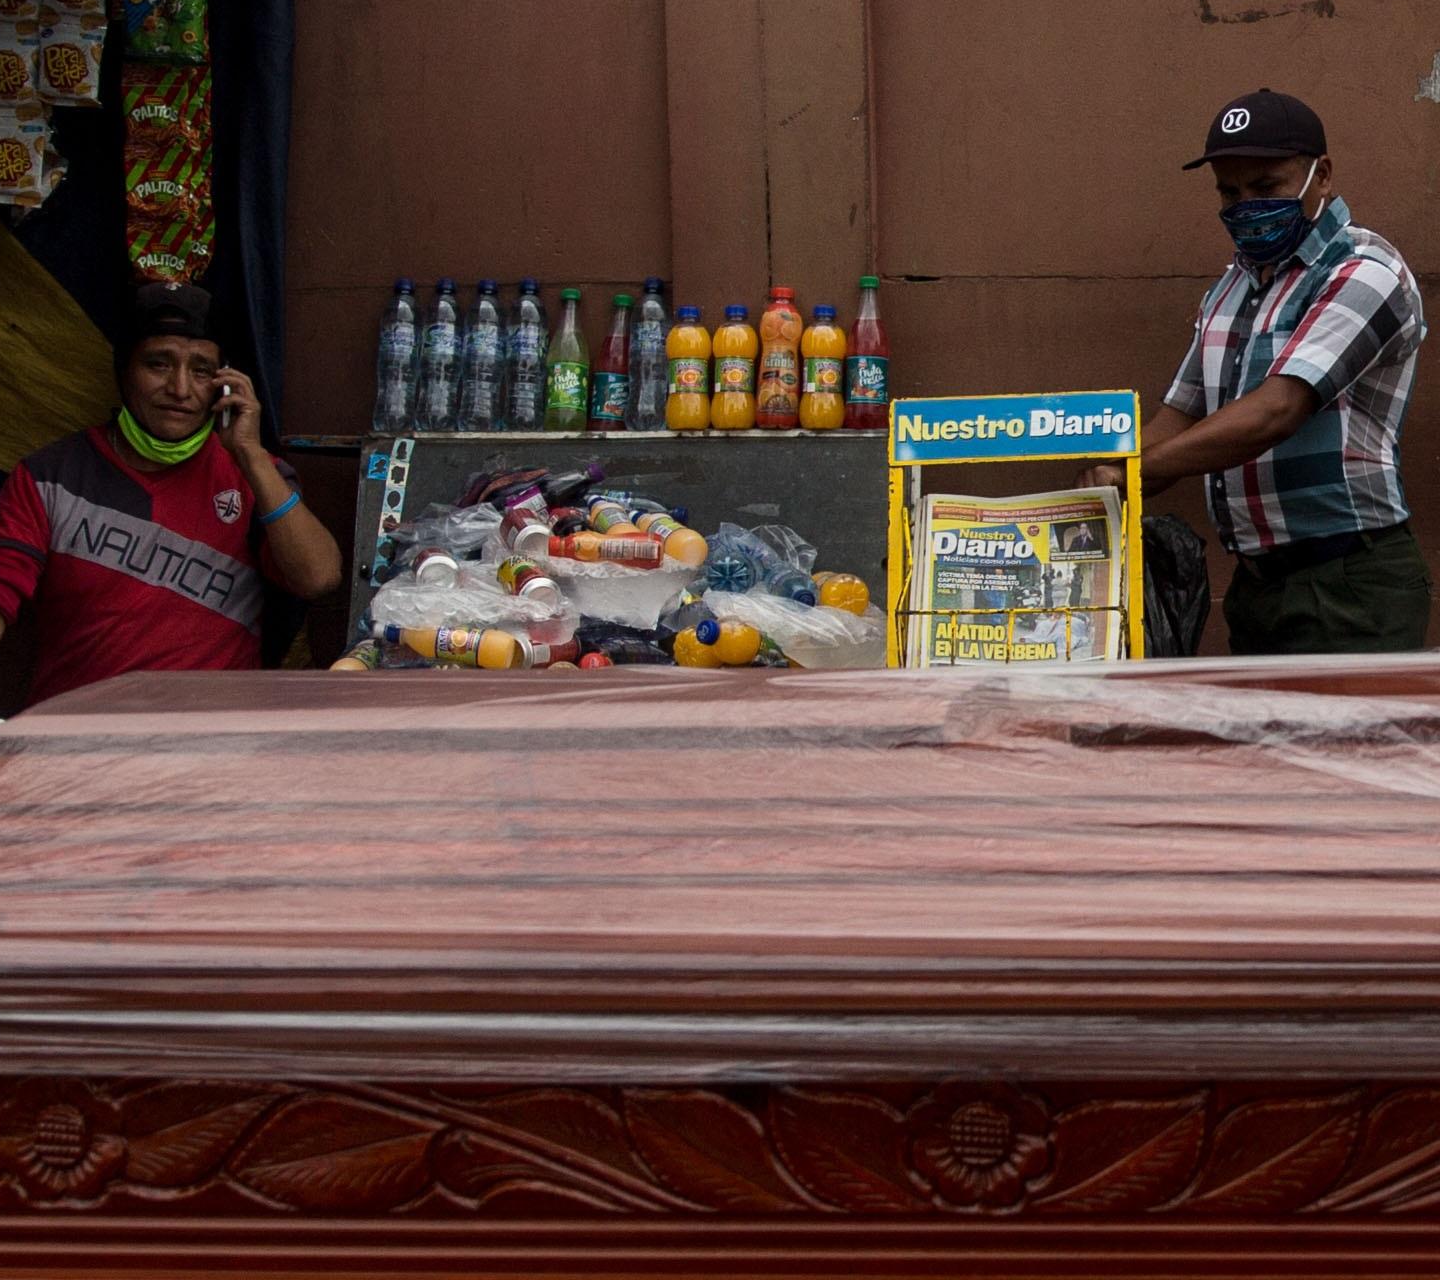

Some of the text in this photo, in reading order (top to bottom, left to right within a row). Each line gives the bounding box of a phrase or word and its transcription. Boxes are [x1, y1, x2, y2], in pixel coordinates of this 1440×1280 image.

[131, 105, 178, 123] PALITOS
[135, 180, 183, 198] PALITOS
[139, 253, 186, 271] PALITOS
[859, 364, 883, 377] Fruta
[898, 408, 1132, 442] Nuestro Diario
[959, 529, 1015, 540] Nuestro
[933, 531, 1033, 558] Diario
[71, 518, 234, 608] NAUTICA
[943, 554, 978, 564] Noticias
[959, 642, 979, 658] LA
[982, 643, 1056, 660] VERBENA
